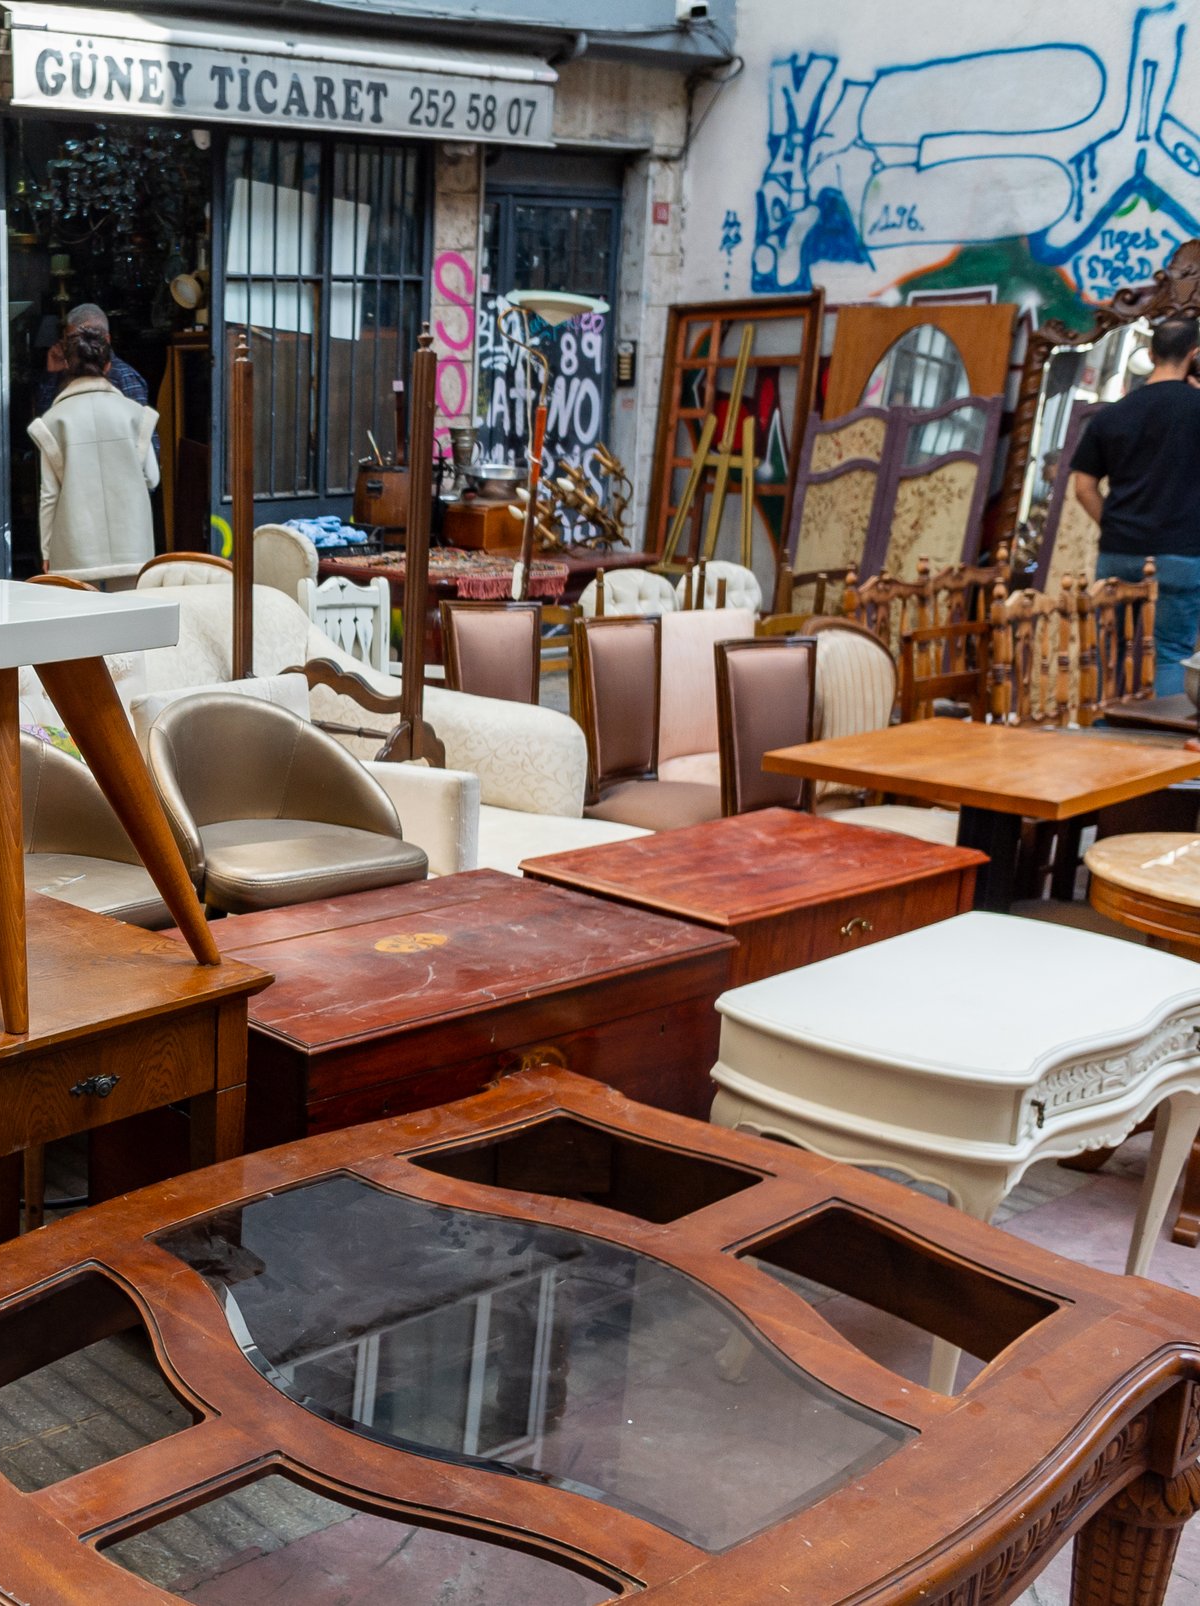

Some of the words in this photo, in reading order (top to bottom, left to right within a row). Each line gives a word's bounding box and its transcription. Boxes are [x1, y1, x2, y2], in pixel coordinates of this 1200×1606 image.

[35, 39, 192, 107] GÜNEY
[210, 56, 388, 124] TİCARET
[408, 86, 456, 129] 252
[466, 93, 497, 132] 58
[507, 98, 537, 136] 07
